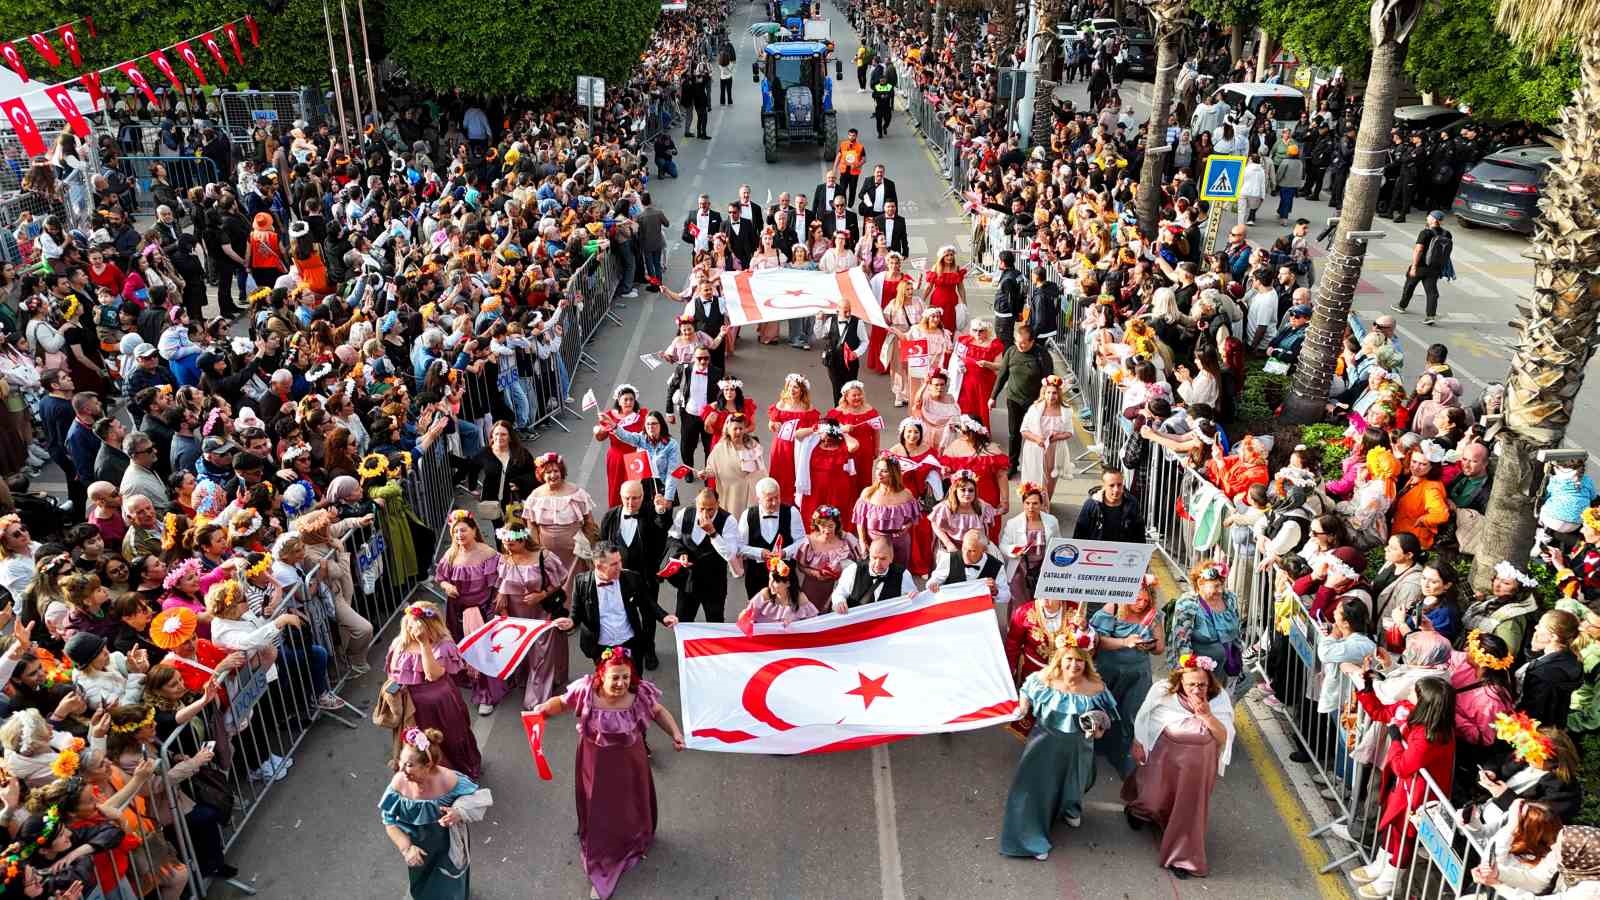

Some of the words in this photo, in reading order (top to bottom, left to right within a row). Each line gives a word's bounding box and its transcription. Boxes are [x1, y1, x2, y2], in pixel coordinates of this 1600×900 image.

[1077, 573, 1107, 582] ESENTEPE
[1044, 586, 1065, 594] AHENK
[1108, 589, 1134, 598] KOROSU
